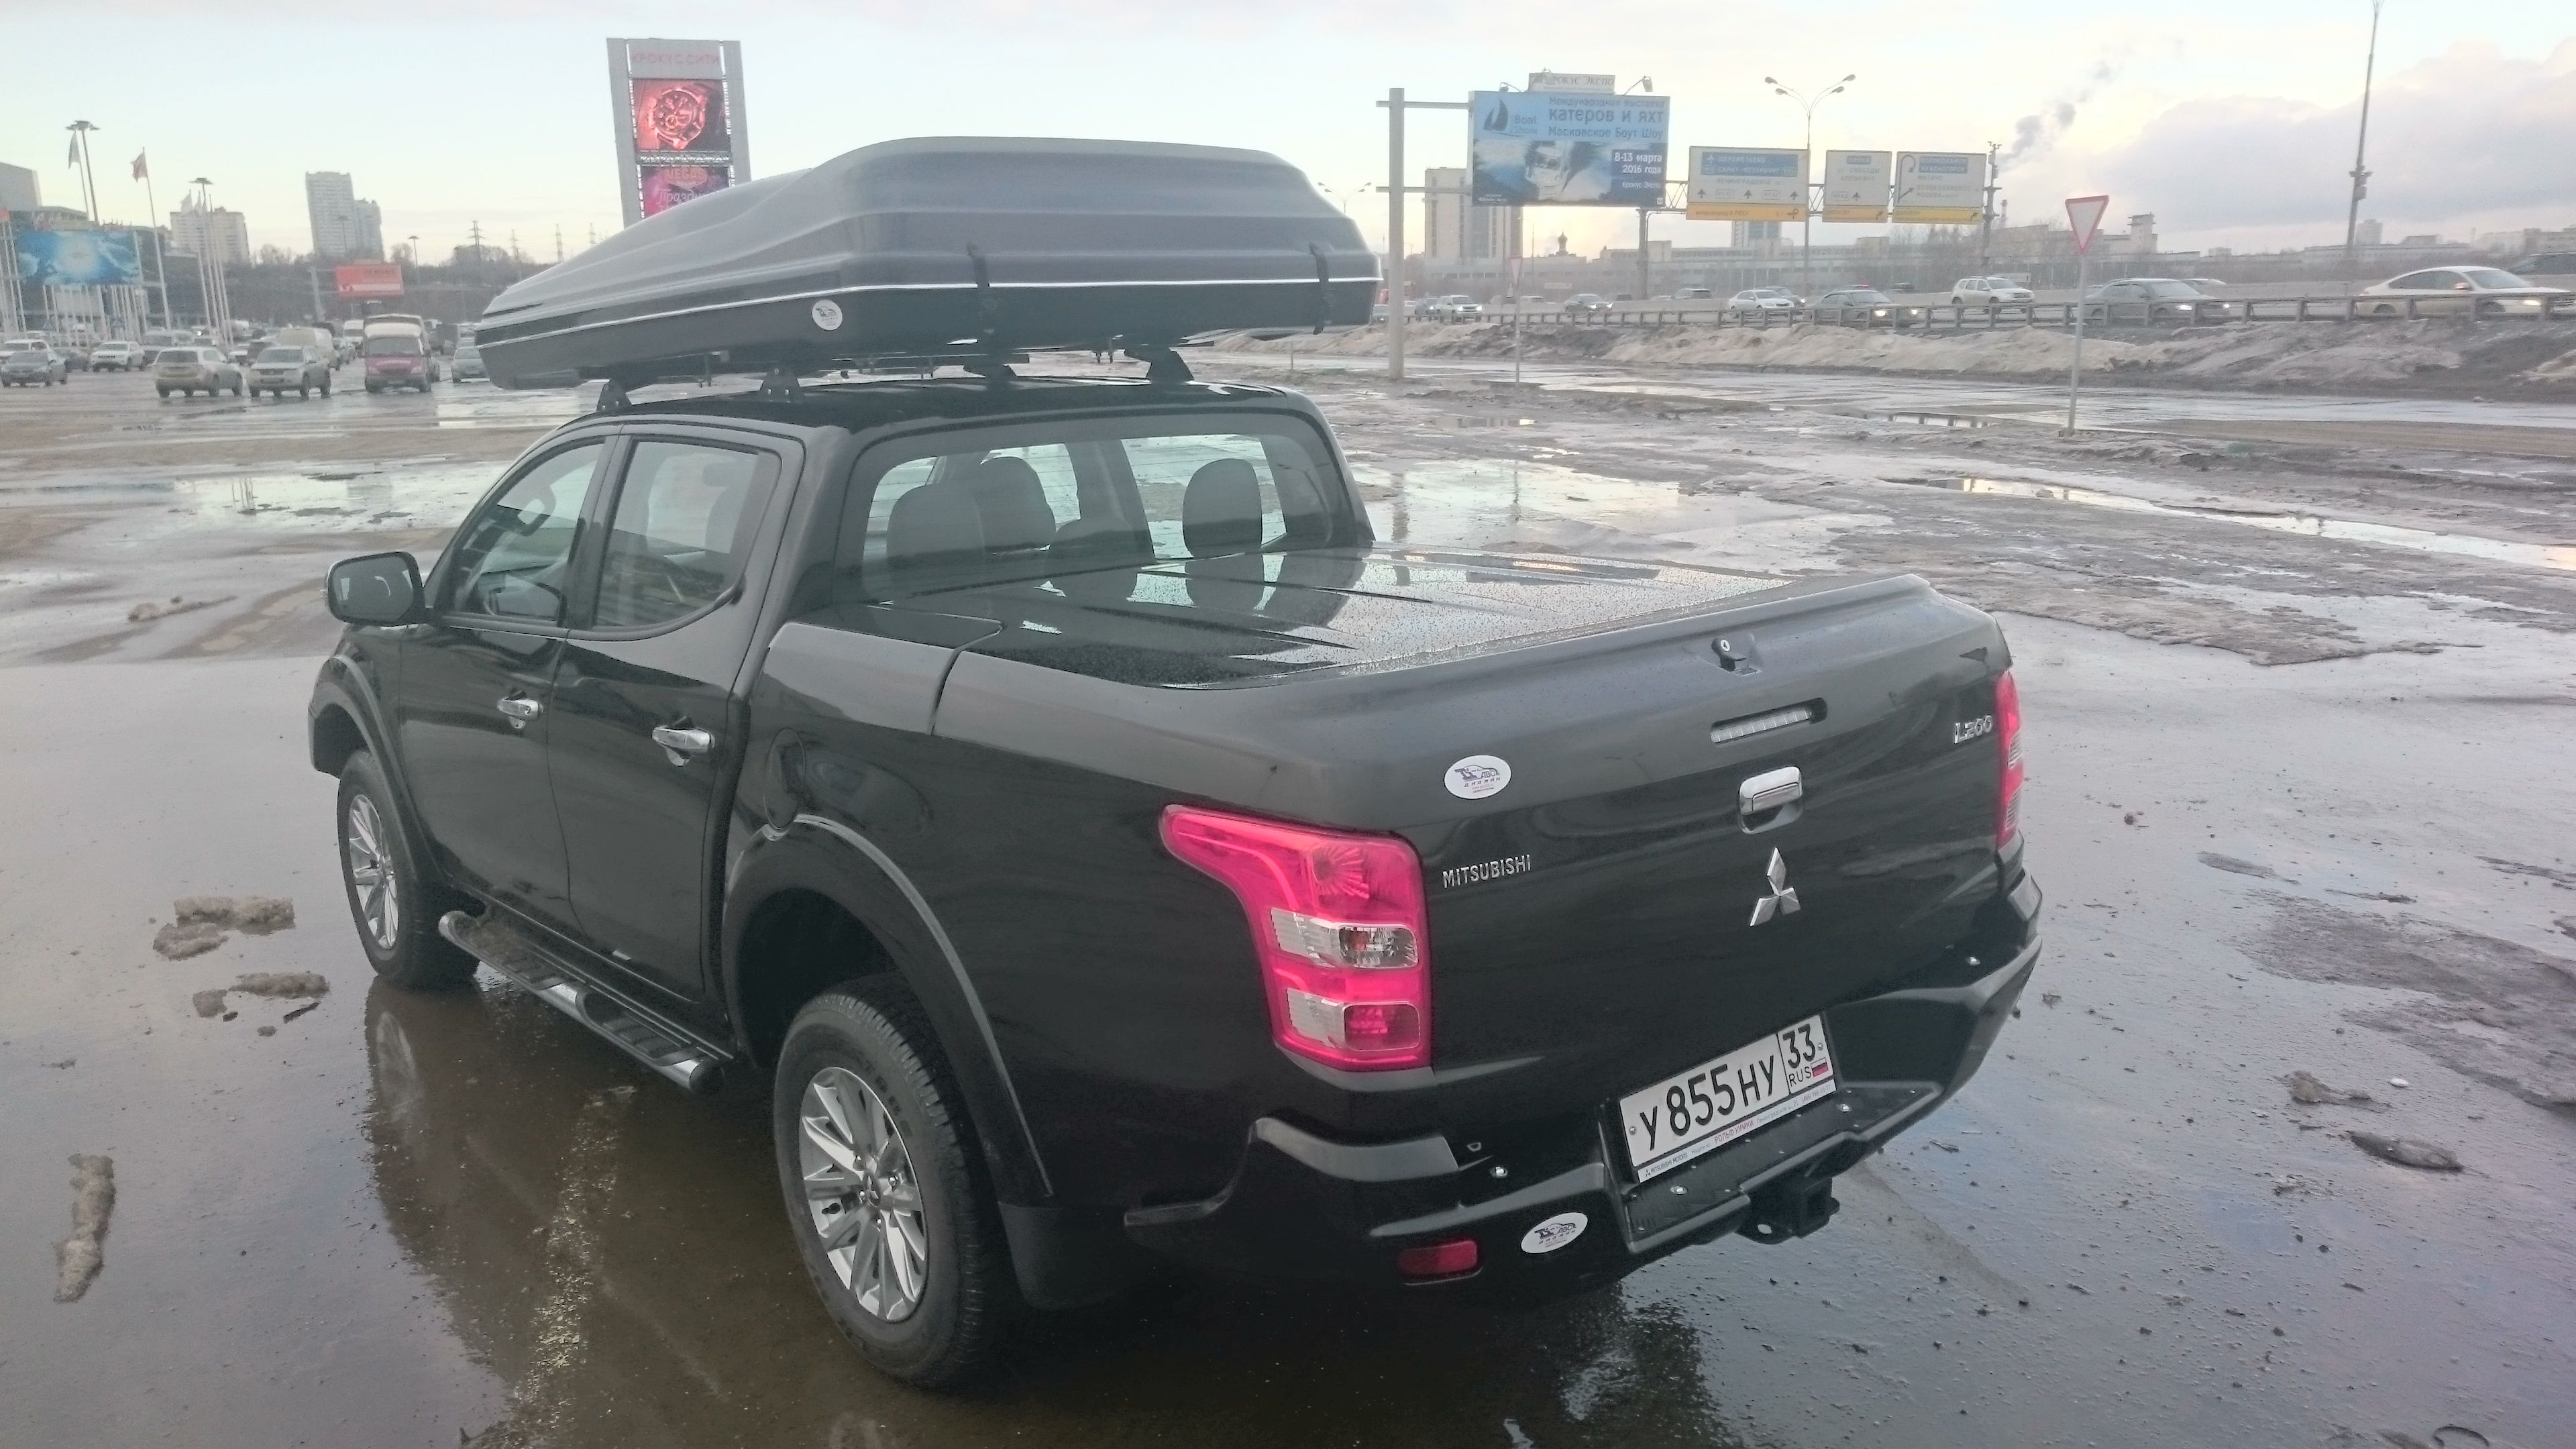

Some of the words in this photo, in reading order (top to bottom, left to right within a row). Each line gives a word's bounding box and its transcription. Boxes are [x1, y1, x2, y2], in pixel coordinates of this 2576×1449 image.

[631, 53, 683, 64] КРОКУС
[686, 54, 720, 64] СИТИ
[1549, 97, 1621, 107] Международная
[1515, 113, 1538, 124] Boat
[1549, 109, 1615, 123] катеров
[1622, 110, 1631, 122] и
[1638, 111, 1664, 123] яхт
[1548, 126, 1611, 137] Московское
[1615, 127, 1637, 140] Боут
[1642, 128, 1664, 140] Шоу
[1614, 152, 1633, 162] 8-13
[1637, 155, 1662, 164] марта
[1623, 165, 1642, 173] 2016
[1954, 715, 1992, 744] L200
[1442, 854, 1531, 888] MITSUBISHI
[1782, 1024, 1816, 1069] 33
[1789, 1066, 1812, 1087] RUS
[1714, 1130, 1735, 1144] РОЛЬФ
[1735, 1119, 1755, 1134] ХИМКИ
[1650, 1159, 1672, 1173] MITSUBISHI
